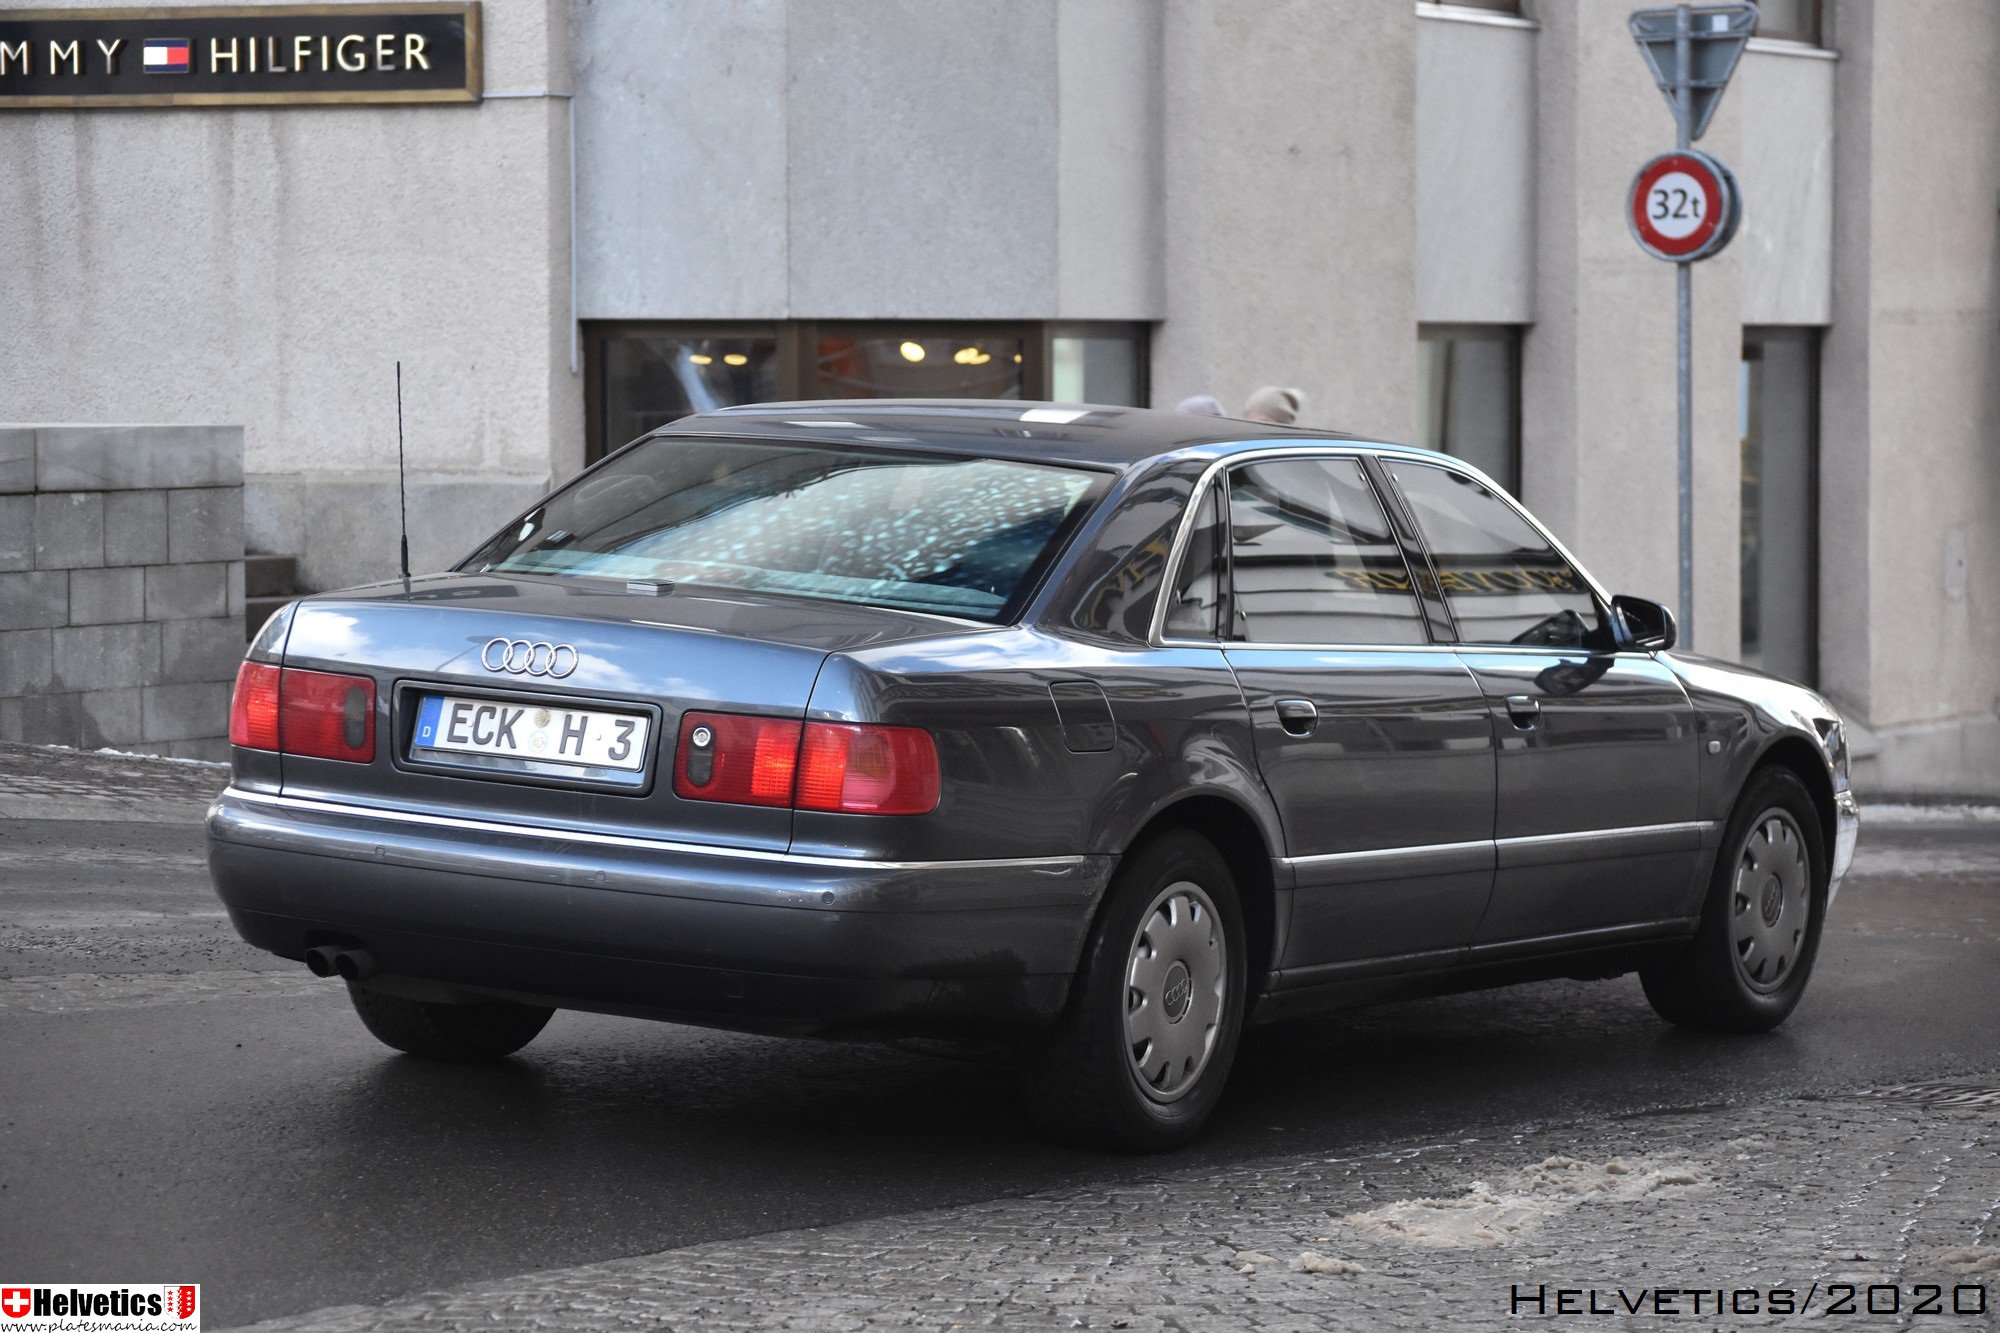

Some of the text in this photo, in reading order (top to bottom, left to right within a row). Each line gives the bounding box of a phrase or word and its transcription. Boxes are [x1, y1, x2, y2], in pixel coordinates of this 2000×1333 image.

[0, 34, 431, 75] MMY HILFIGER
[1651, 188, 1702, 220] 32t
[421, 726, 431, 738] D
[446, 702, 636, 761] ECK H 3
